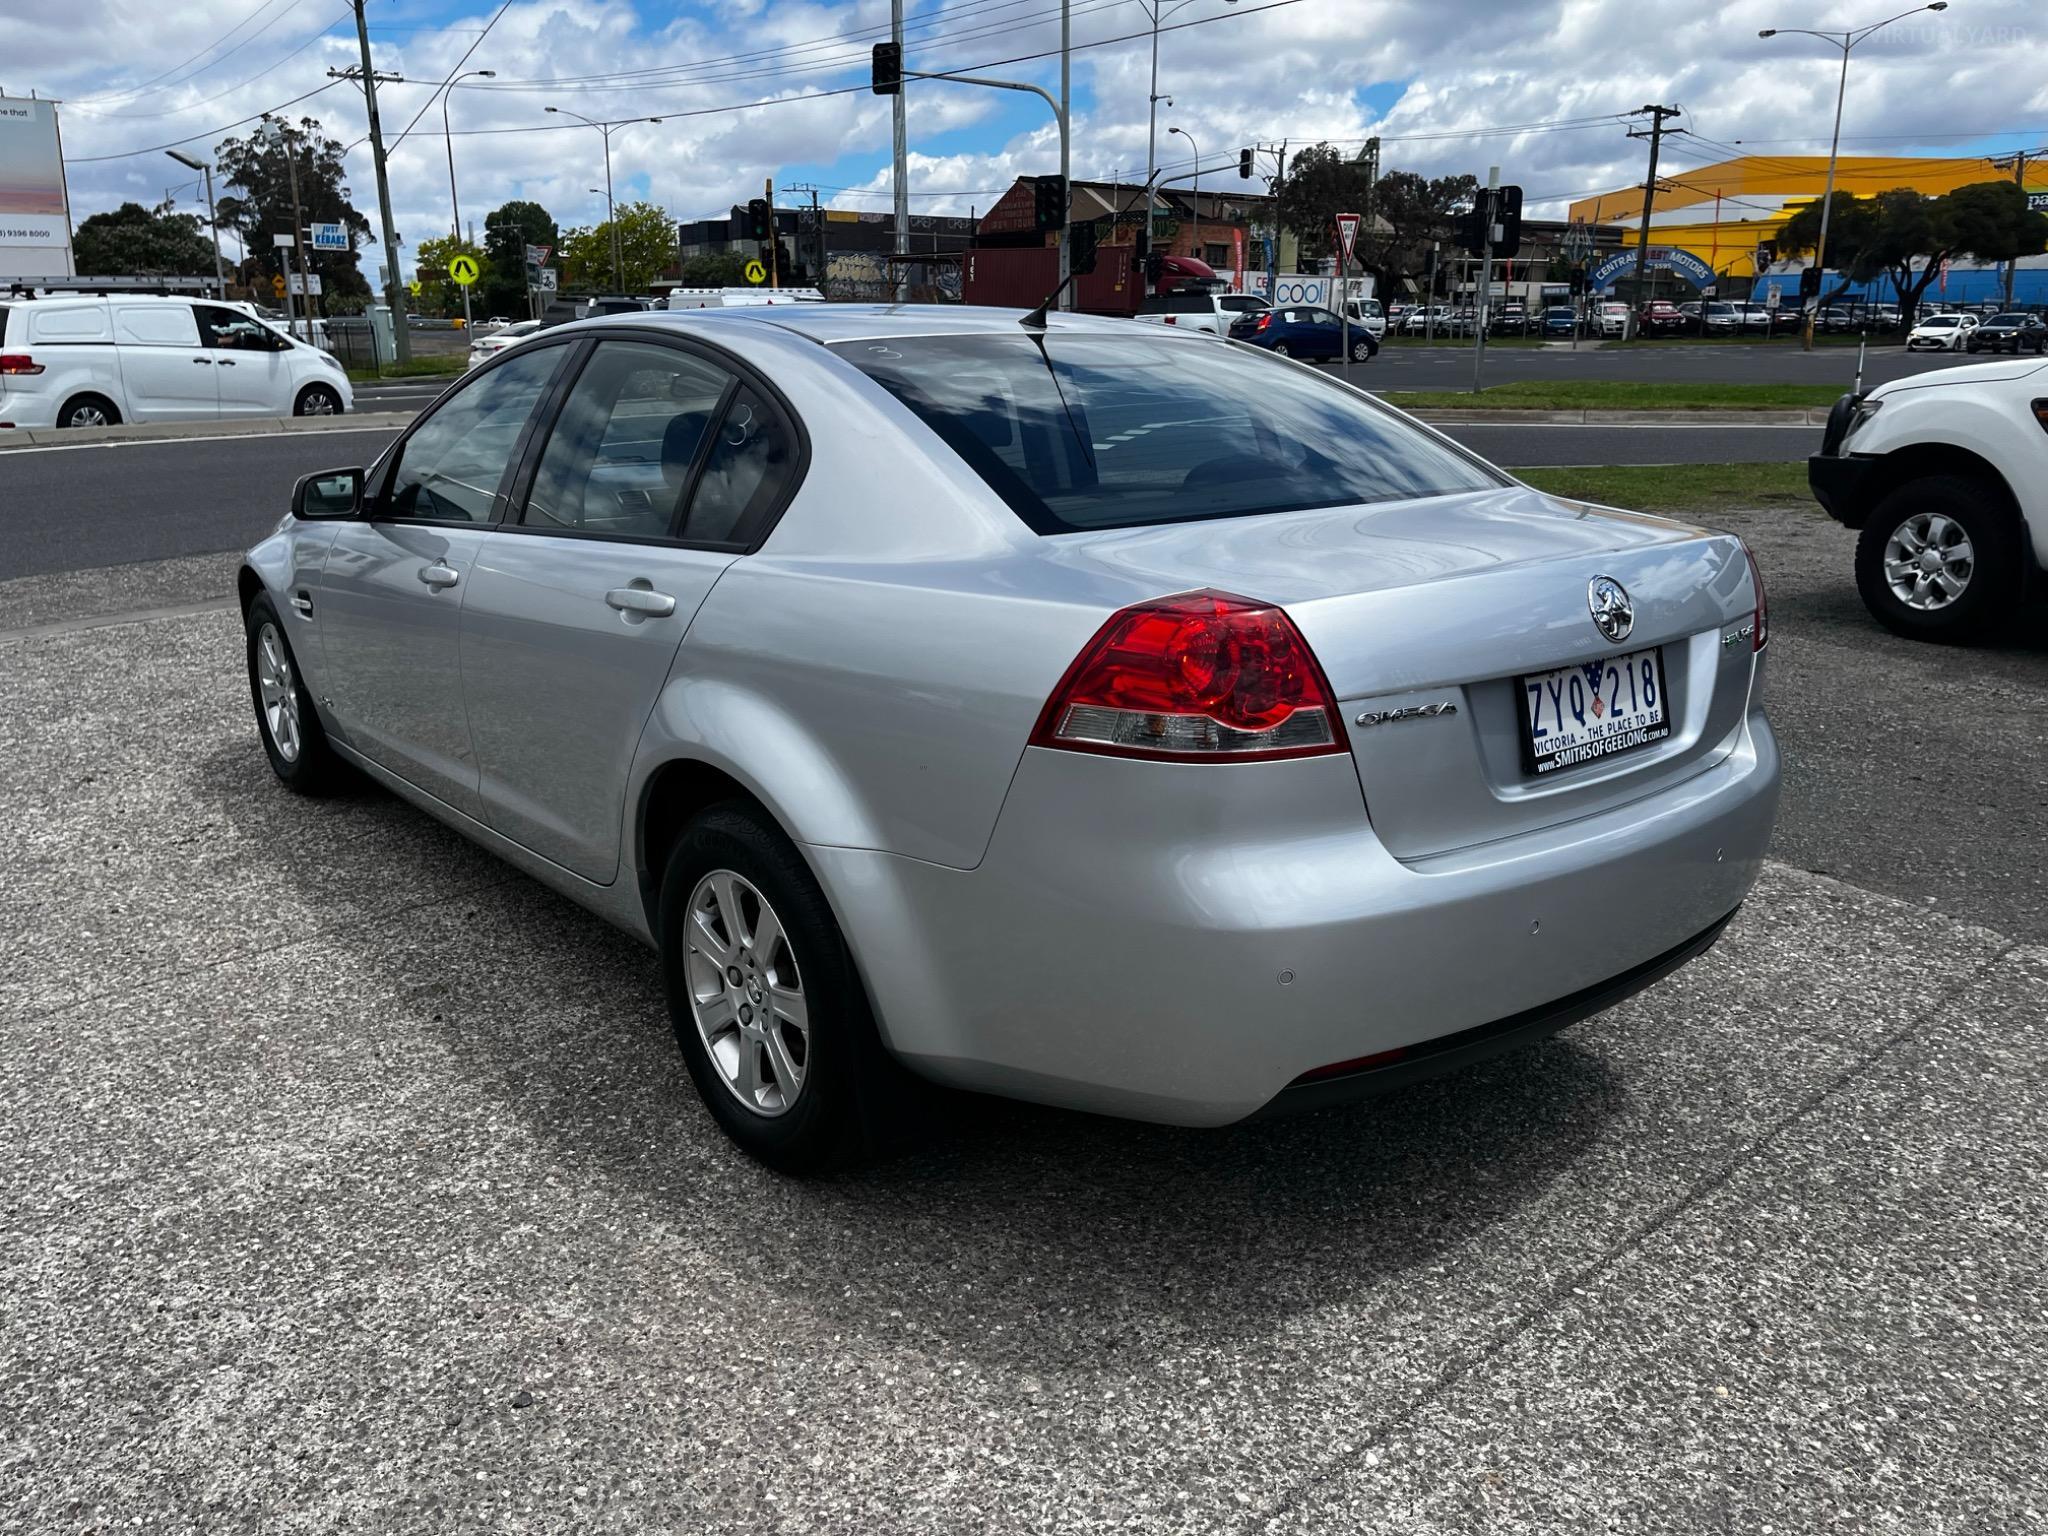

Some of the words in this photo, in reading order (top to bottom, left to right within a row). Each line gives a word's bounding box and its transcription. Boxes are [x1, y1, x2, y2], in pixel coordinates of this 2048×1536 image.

[9, 108, 28, 117] that
[322, 225, 339, 235] JUST
[1343, 223, 1353, 232] GIVE
[29, 230, 50, 238] 8000
[315, 234, 347, 245] KEBABZ
[1595, 252, 1638, 280] CENTRAL
[1669, 252, 1709, 279] MOTORS
[1528, 674, 1587, 738] ZYQ
[1606, 658, 1657, 718] 218
[1355, 702, 1458, 727] OMEGA
[1534, 733, 1577, 752] VICTORIA
[1587, 725, 1604, 741] THE
[1607, 717, 1632, 735] PLACE
[1635, 713, 1646, 726] TO
[1649, 710, 1660, 723] BE
